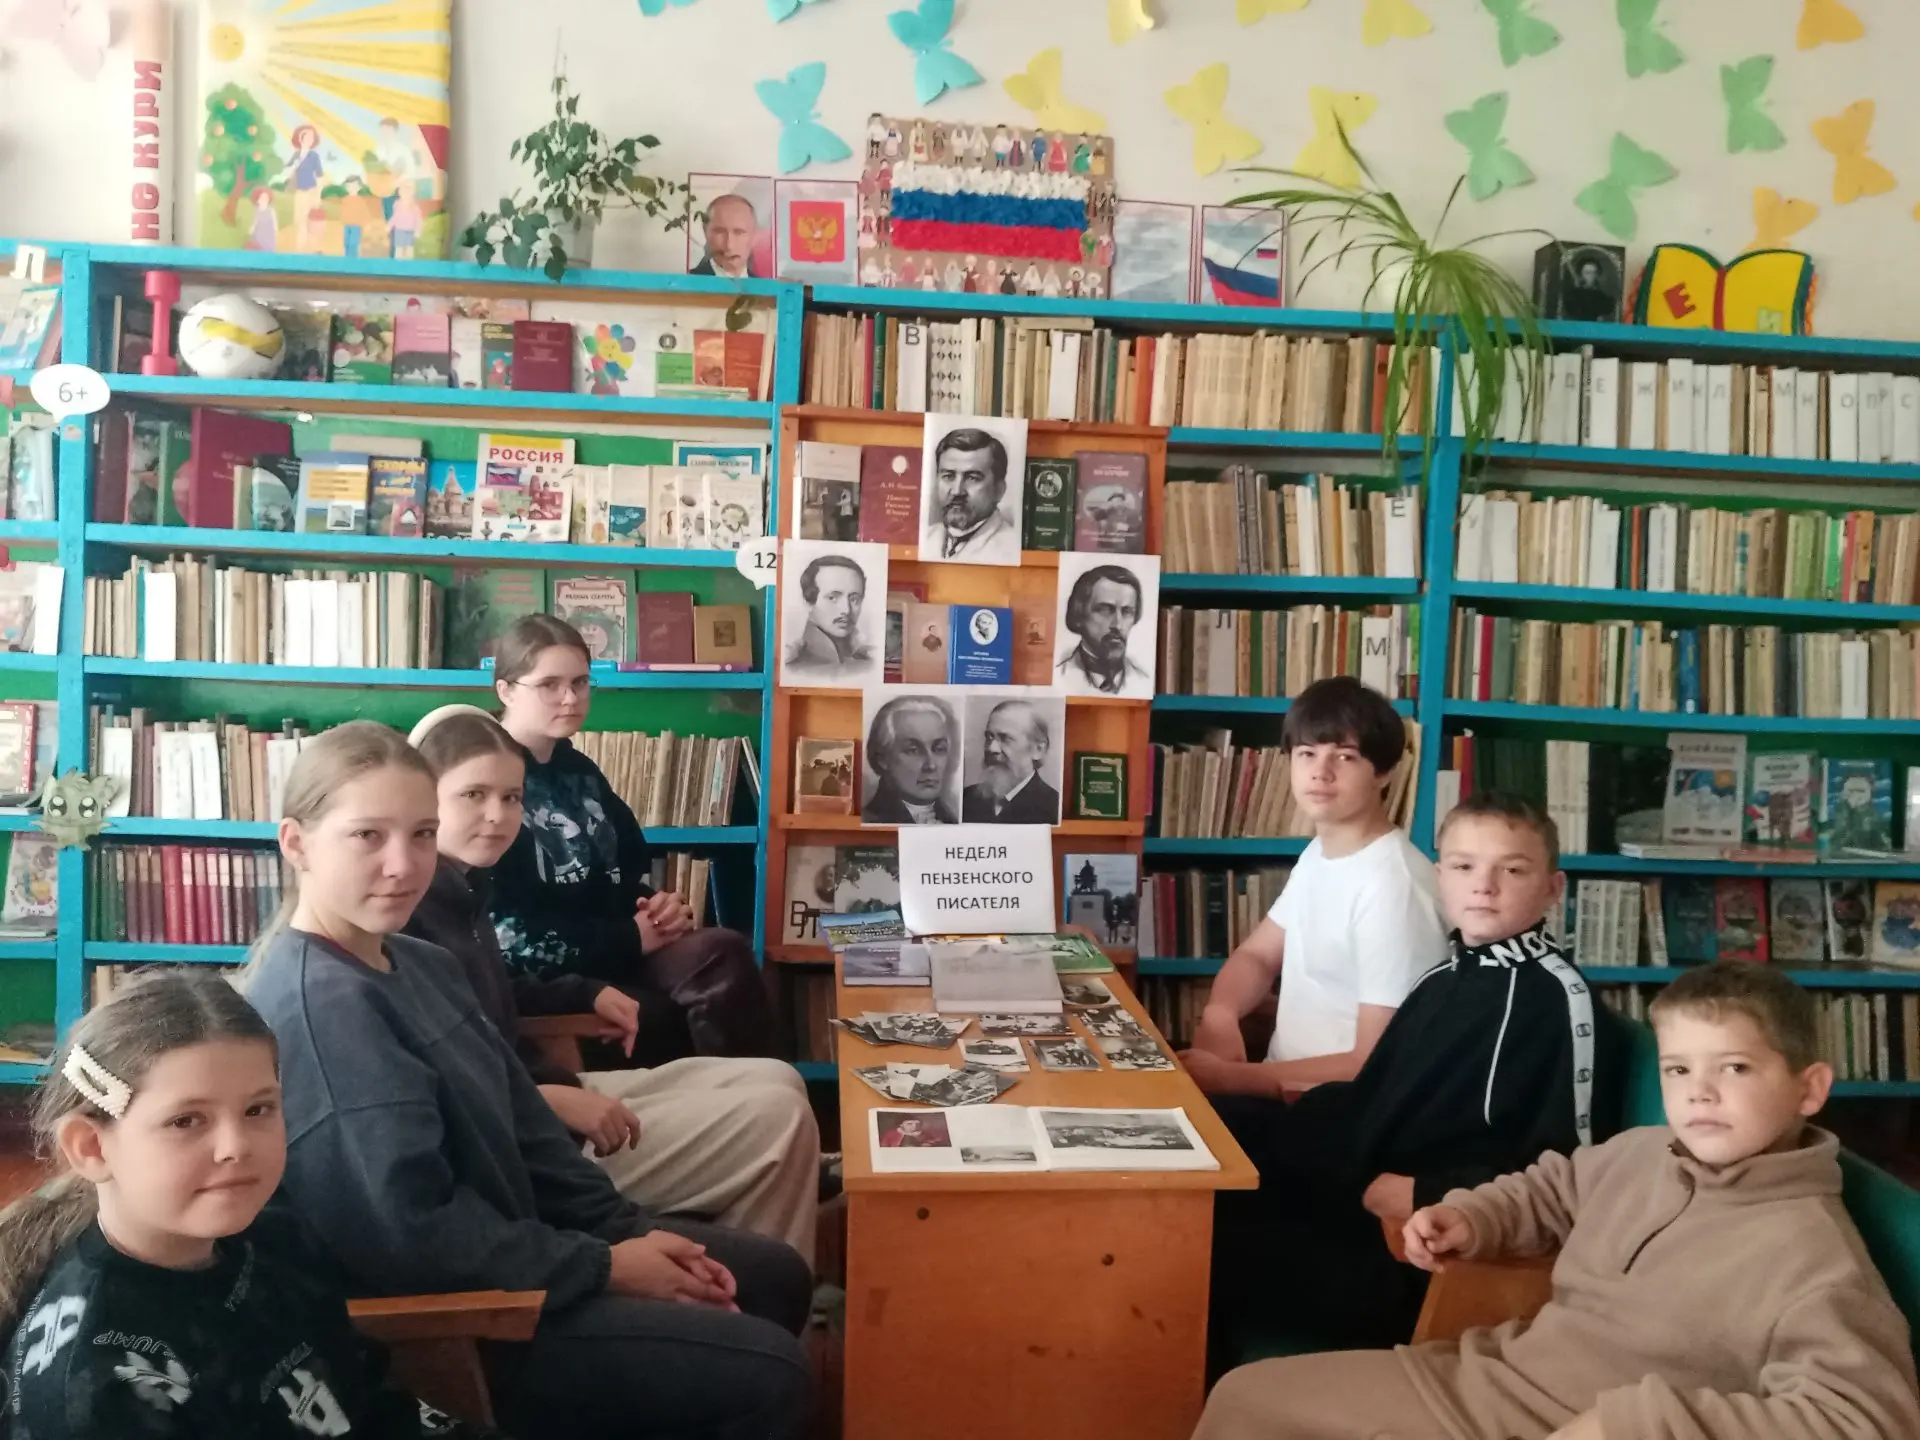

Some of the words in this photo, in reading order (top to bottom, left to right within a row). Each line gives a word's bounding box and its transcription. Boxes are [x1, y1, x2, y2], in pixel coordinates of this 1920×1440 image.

[58, 382, 88, 403] 6+
[489, 447, 565, 463] РОССИЯ
[1366, 637, 1387, 656] М
[945, 846, 1007, 861] НЕДЕЛЯ
[921, 871, 1033, 885] ПЕНЗЕНСКОГО
[937, 896, 1020, 910] ПИСАТЕЛЯ
